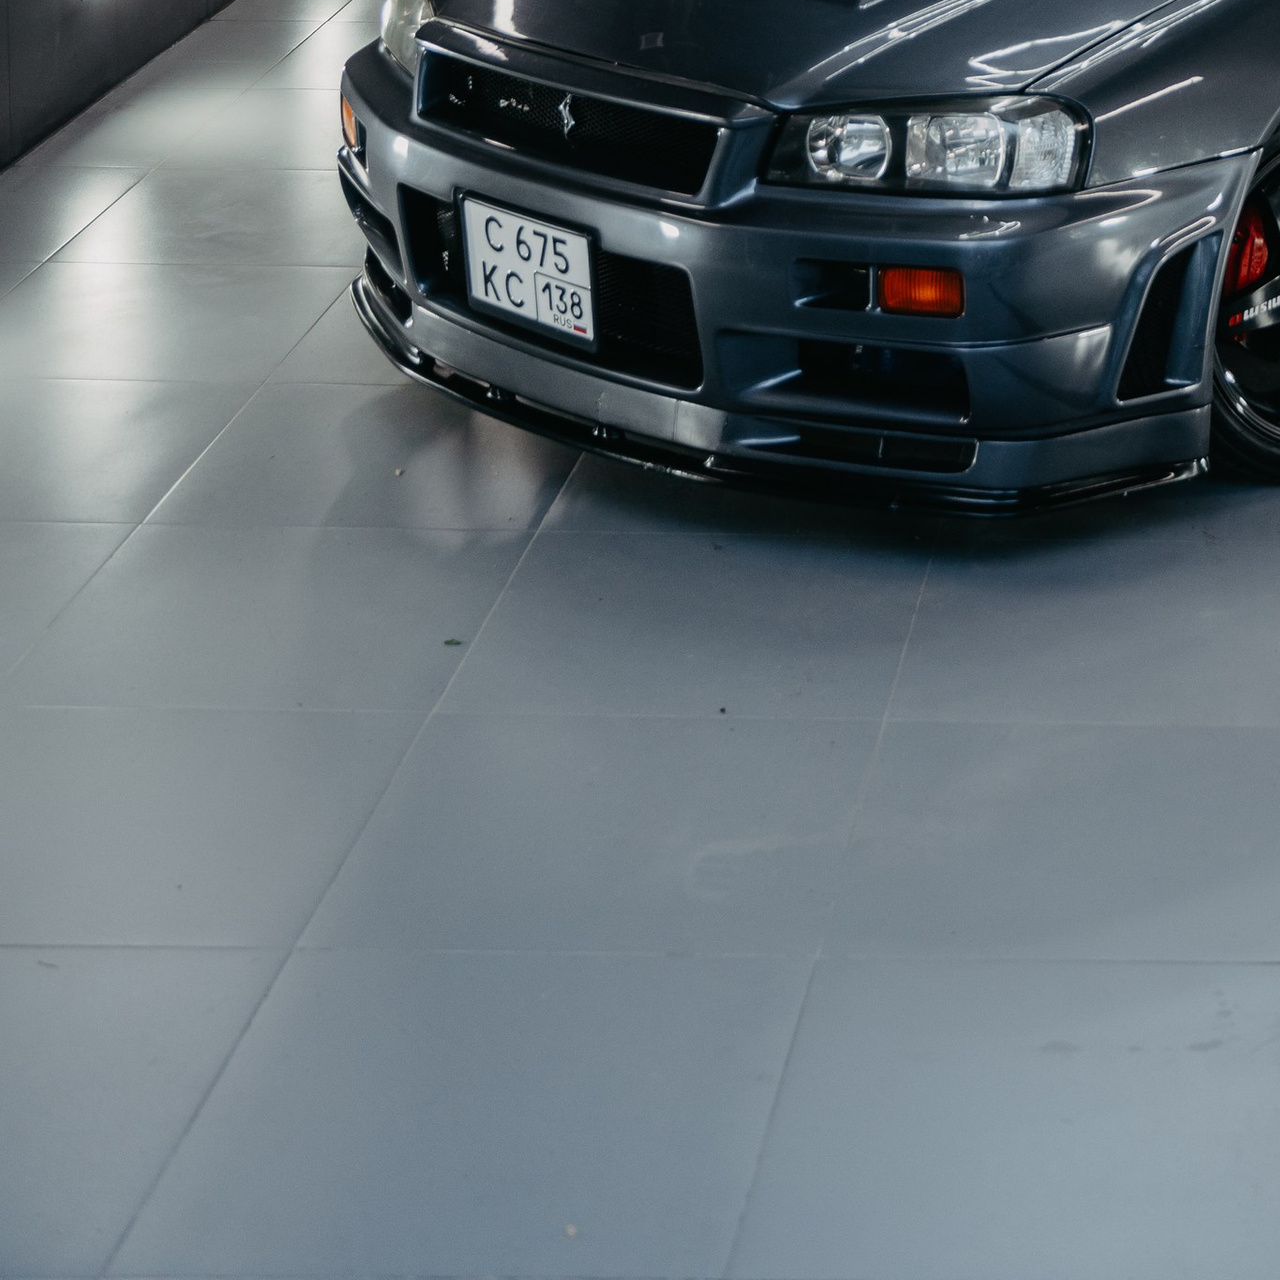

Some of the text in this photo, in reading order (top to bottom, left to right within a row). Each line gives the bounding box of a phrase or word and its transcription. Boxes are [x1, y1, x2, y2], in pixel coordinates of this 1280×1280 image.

[516, 225, 570, 274] 675
[541, 282, 584, 320] 138
[553, 314, 573, 329] RUS
